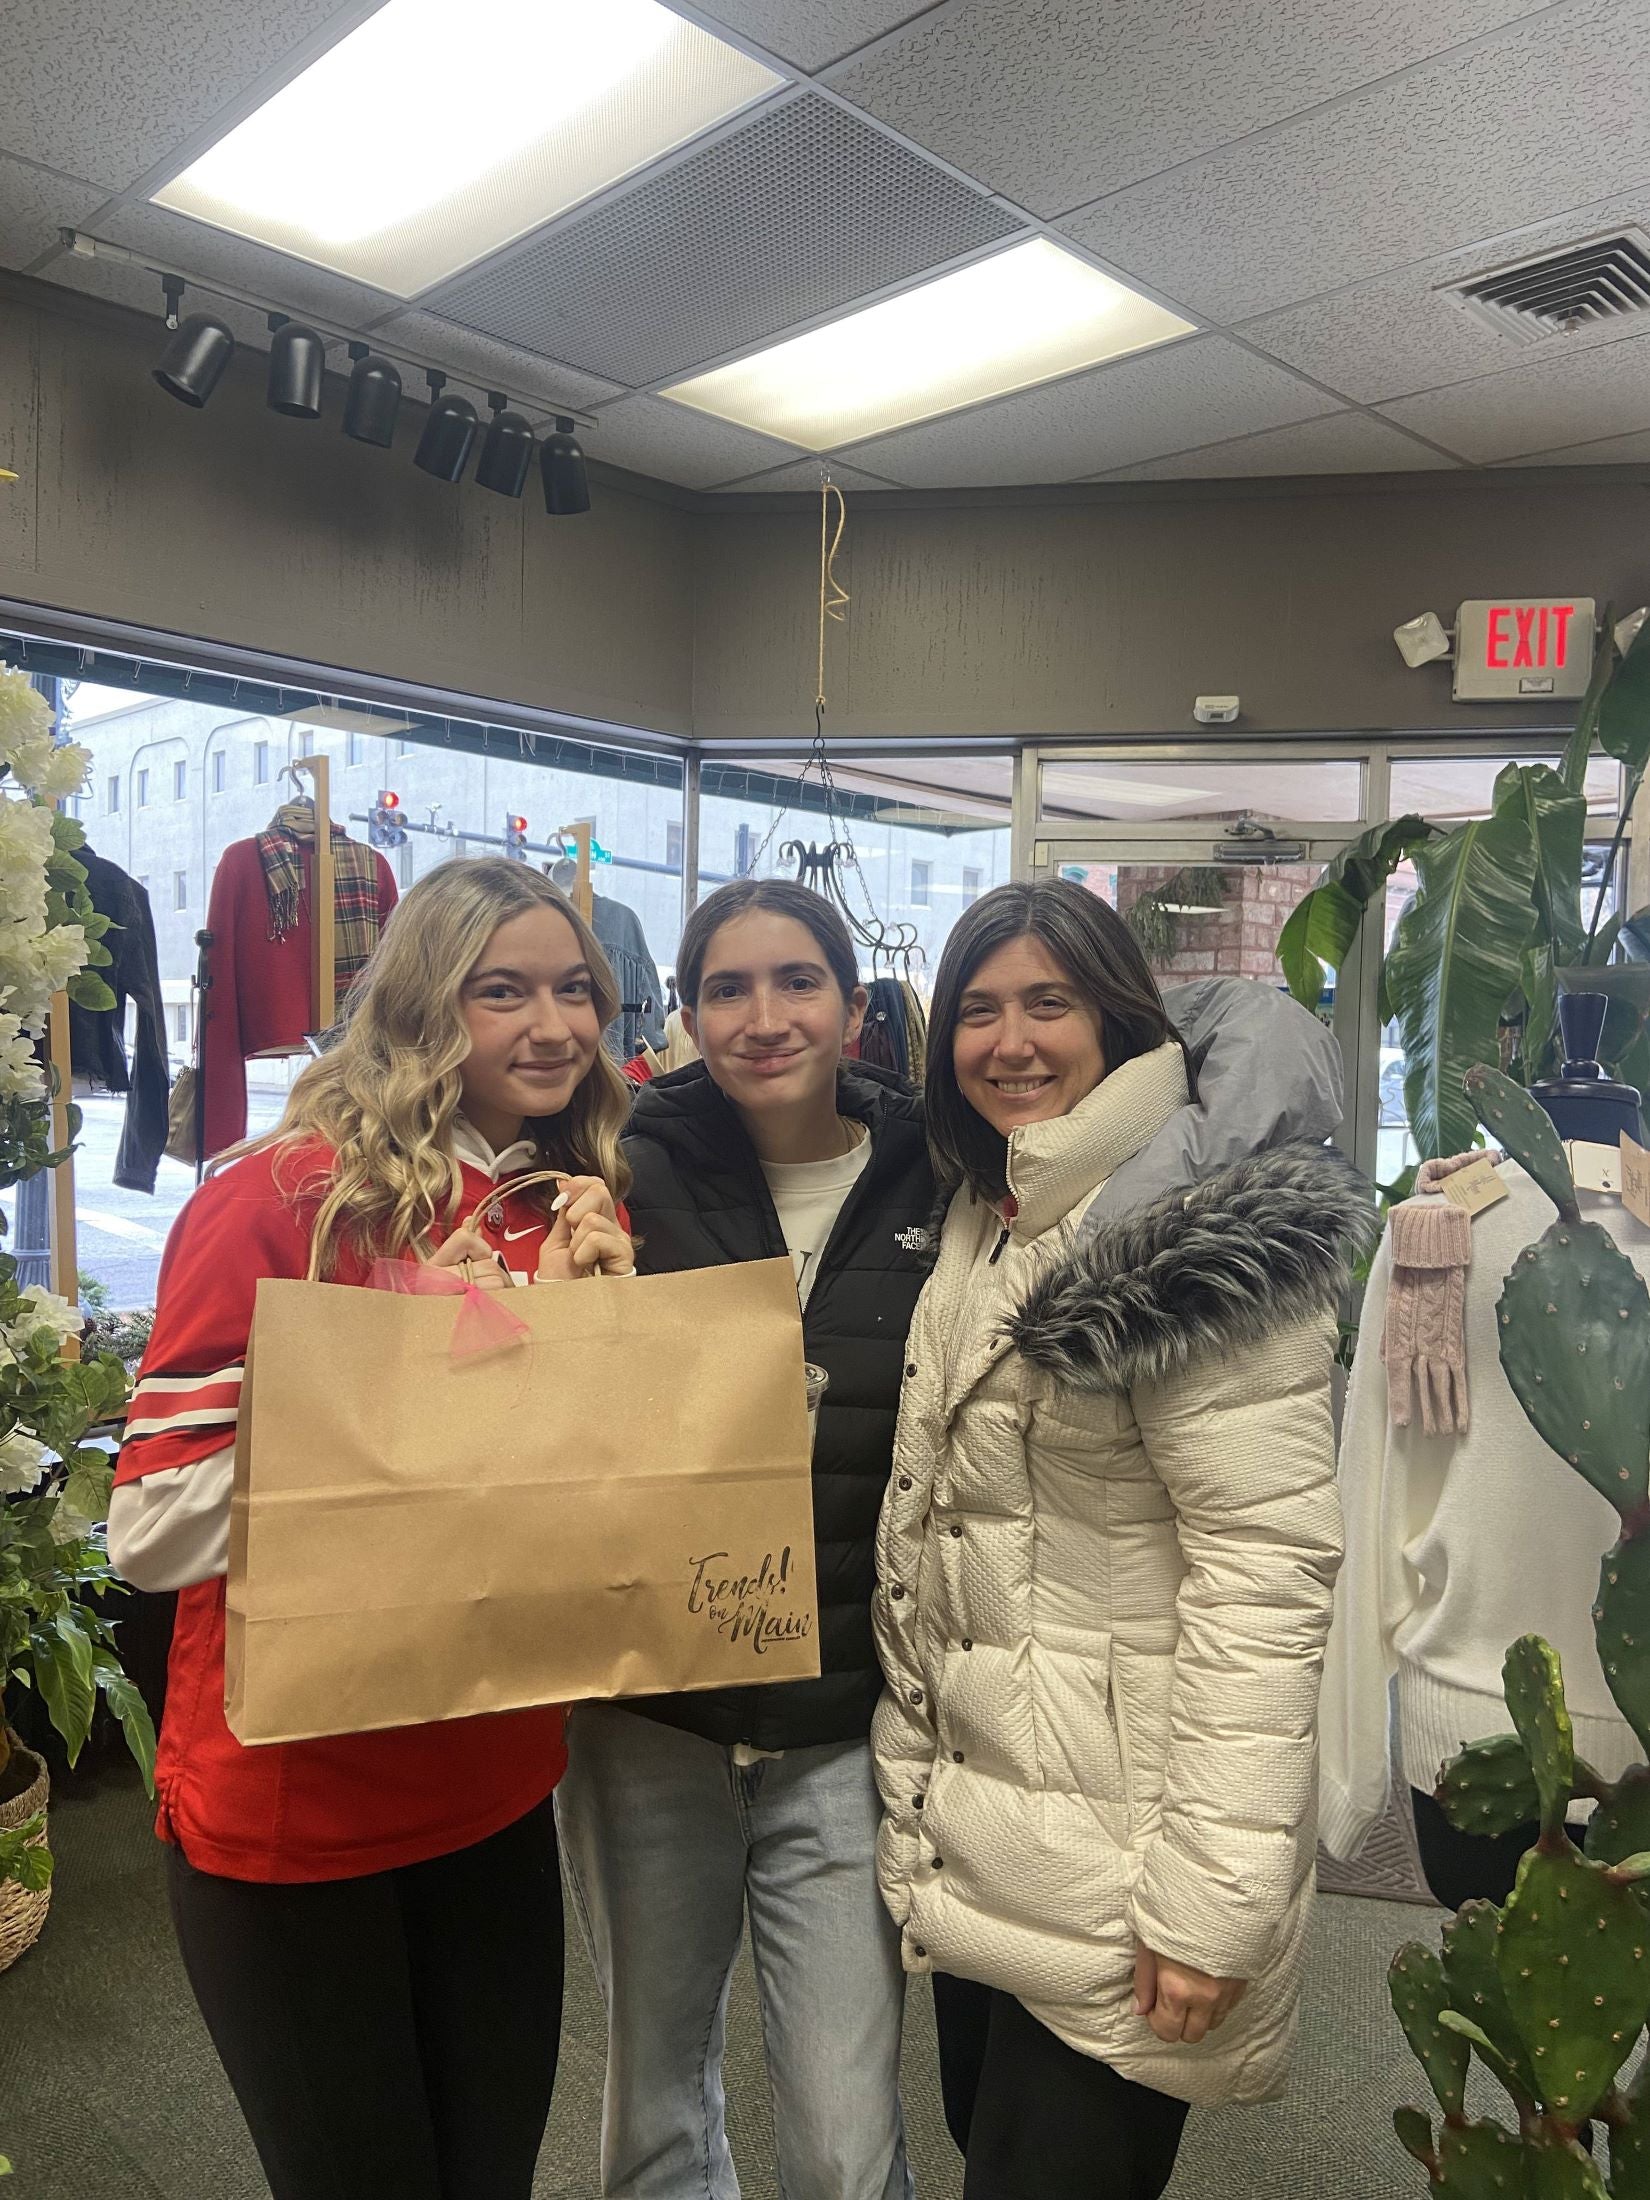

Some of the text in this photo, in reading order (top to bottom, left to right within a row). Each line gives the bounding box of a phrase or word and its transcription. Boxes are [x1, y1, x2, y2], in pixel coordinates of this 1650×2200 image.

[1487, 607, 1574, 668] EXIT
[894, 1232, 921, 1243] NORTH
[906, 1226, 921, 1235] THE
[688, 1546, 791, 1614] Trends!
[718, 1601, 813, 1654] Main
